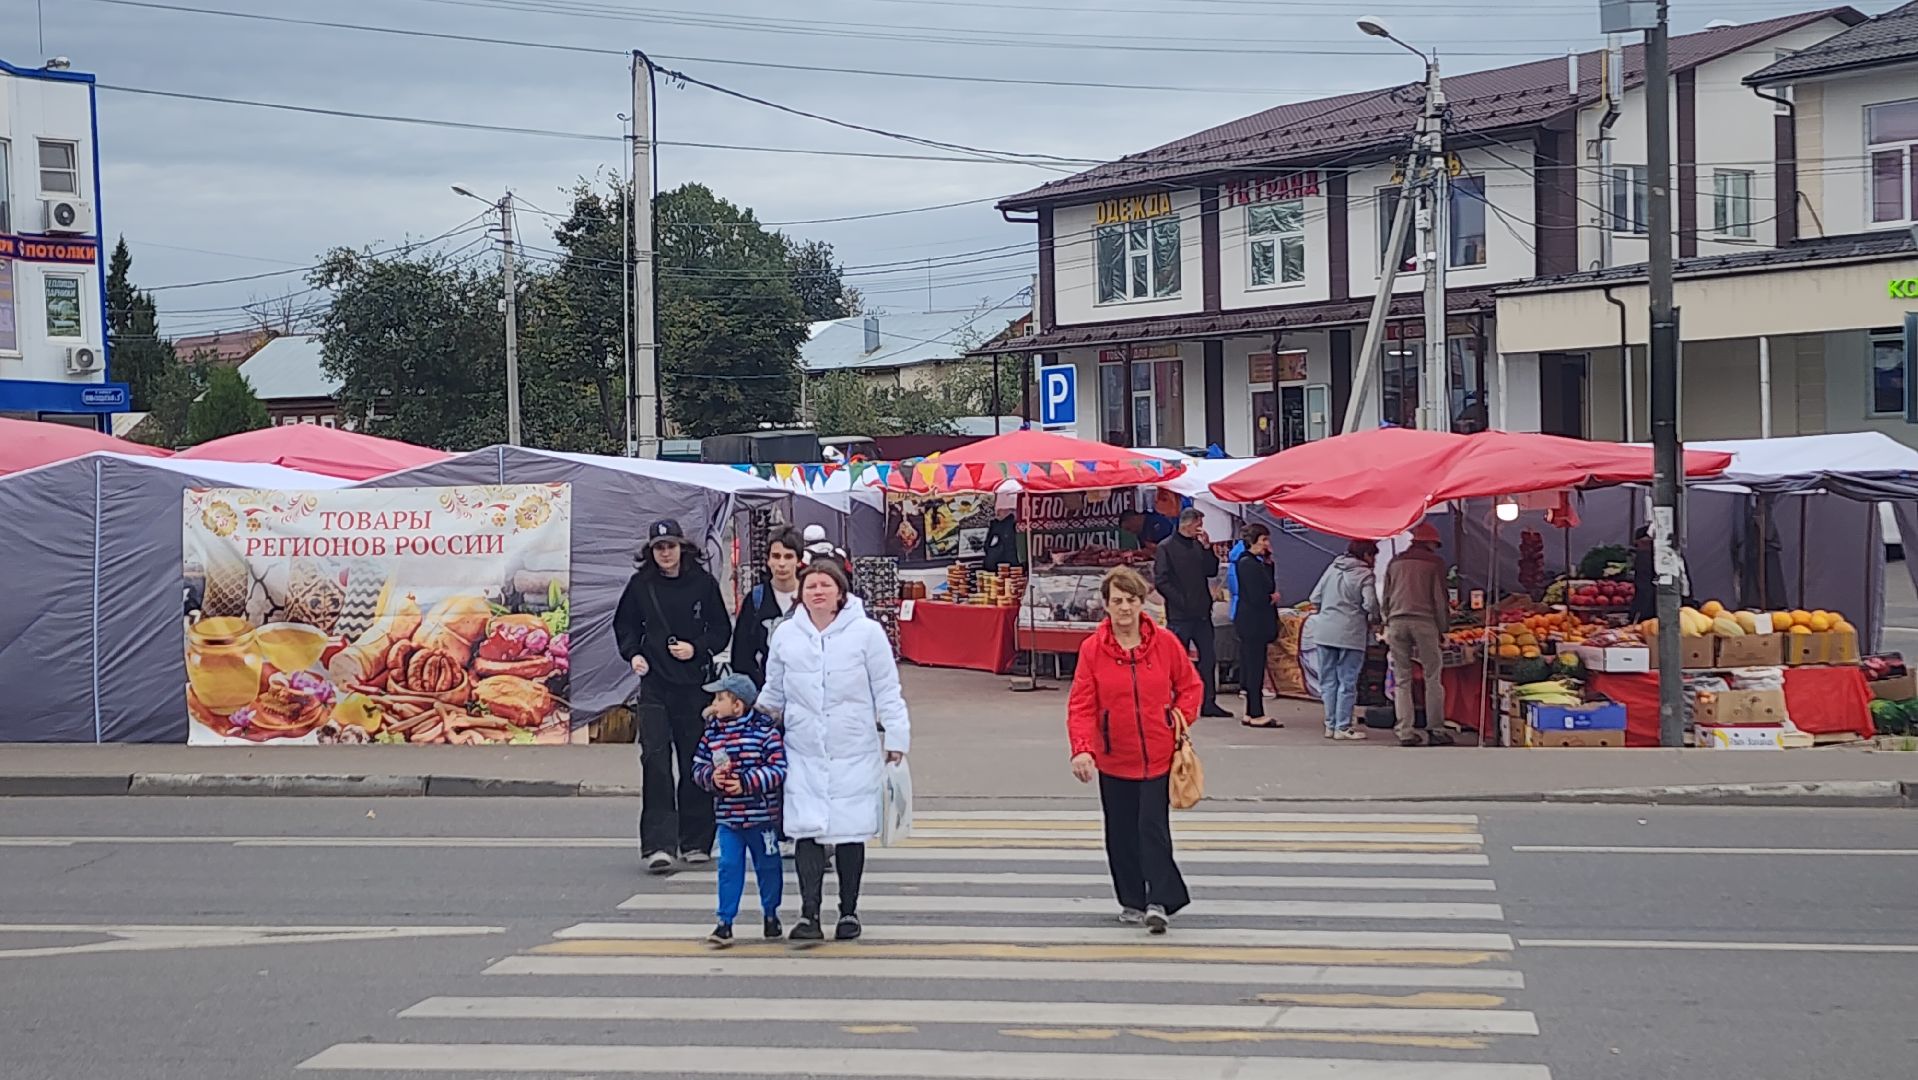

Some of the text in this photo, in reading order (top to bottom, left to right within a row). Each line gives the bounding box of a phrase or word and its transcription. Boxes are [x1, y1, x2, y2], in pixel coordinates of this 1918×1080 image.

[1096, 192, 1170, 224] ОДЕЖДА
[26, 244, 95, 259] ПОТОЛКИ
[1048, 373, 1069, 420] P
[319, 510, 432, 530] ТОВАРЫ
[245, 534, 505, 557] РЕГИОНОВ РОССИИ
